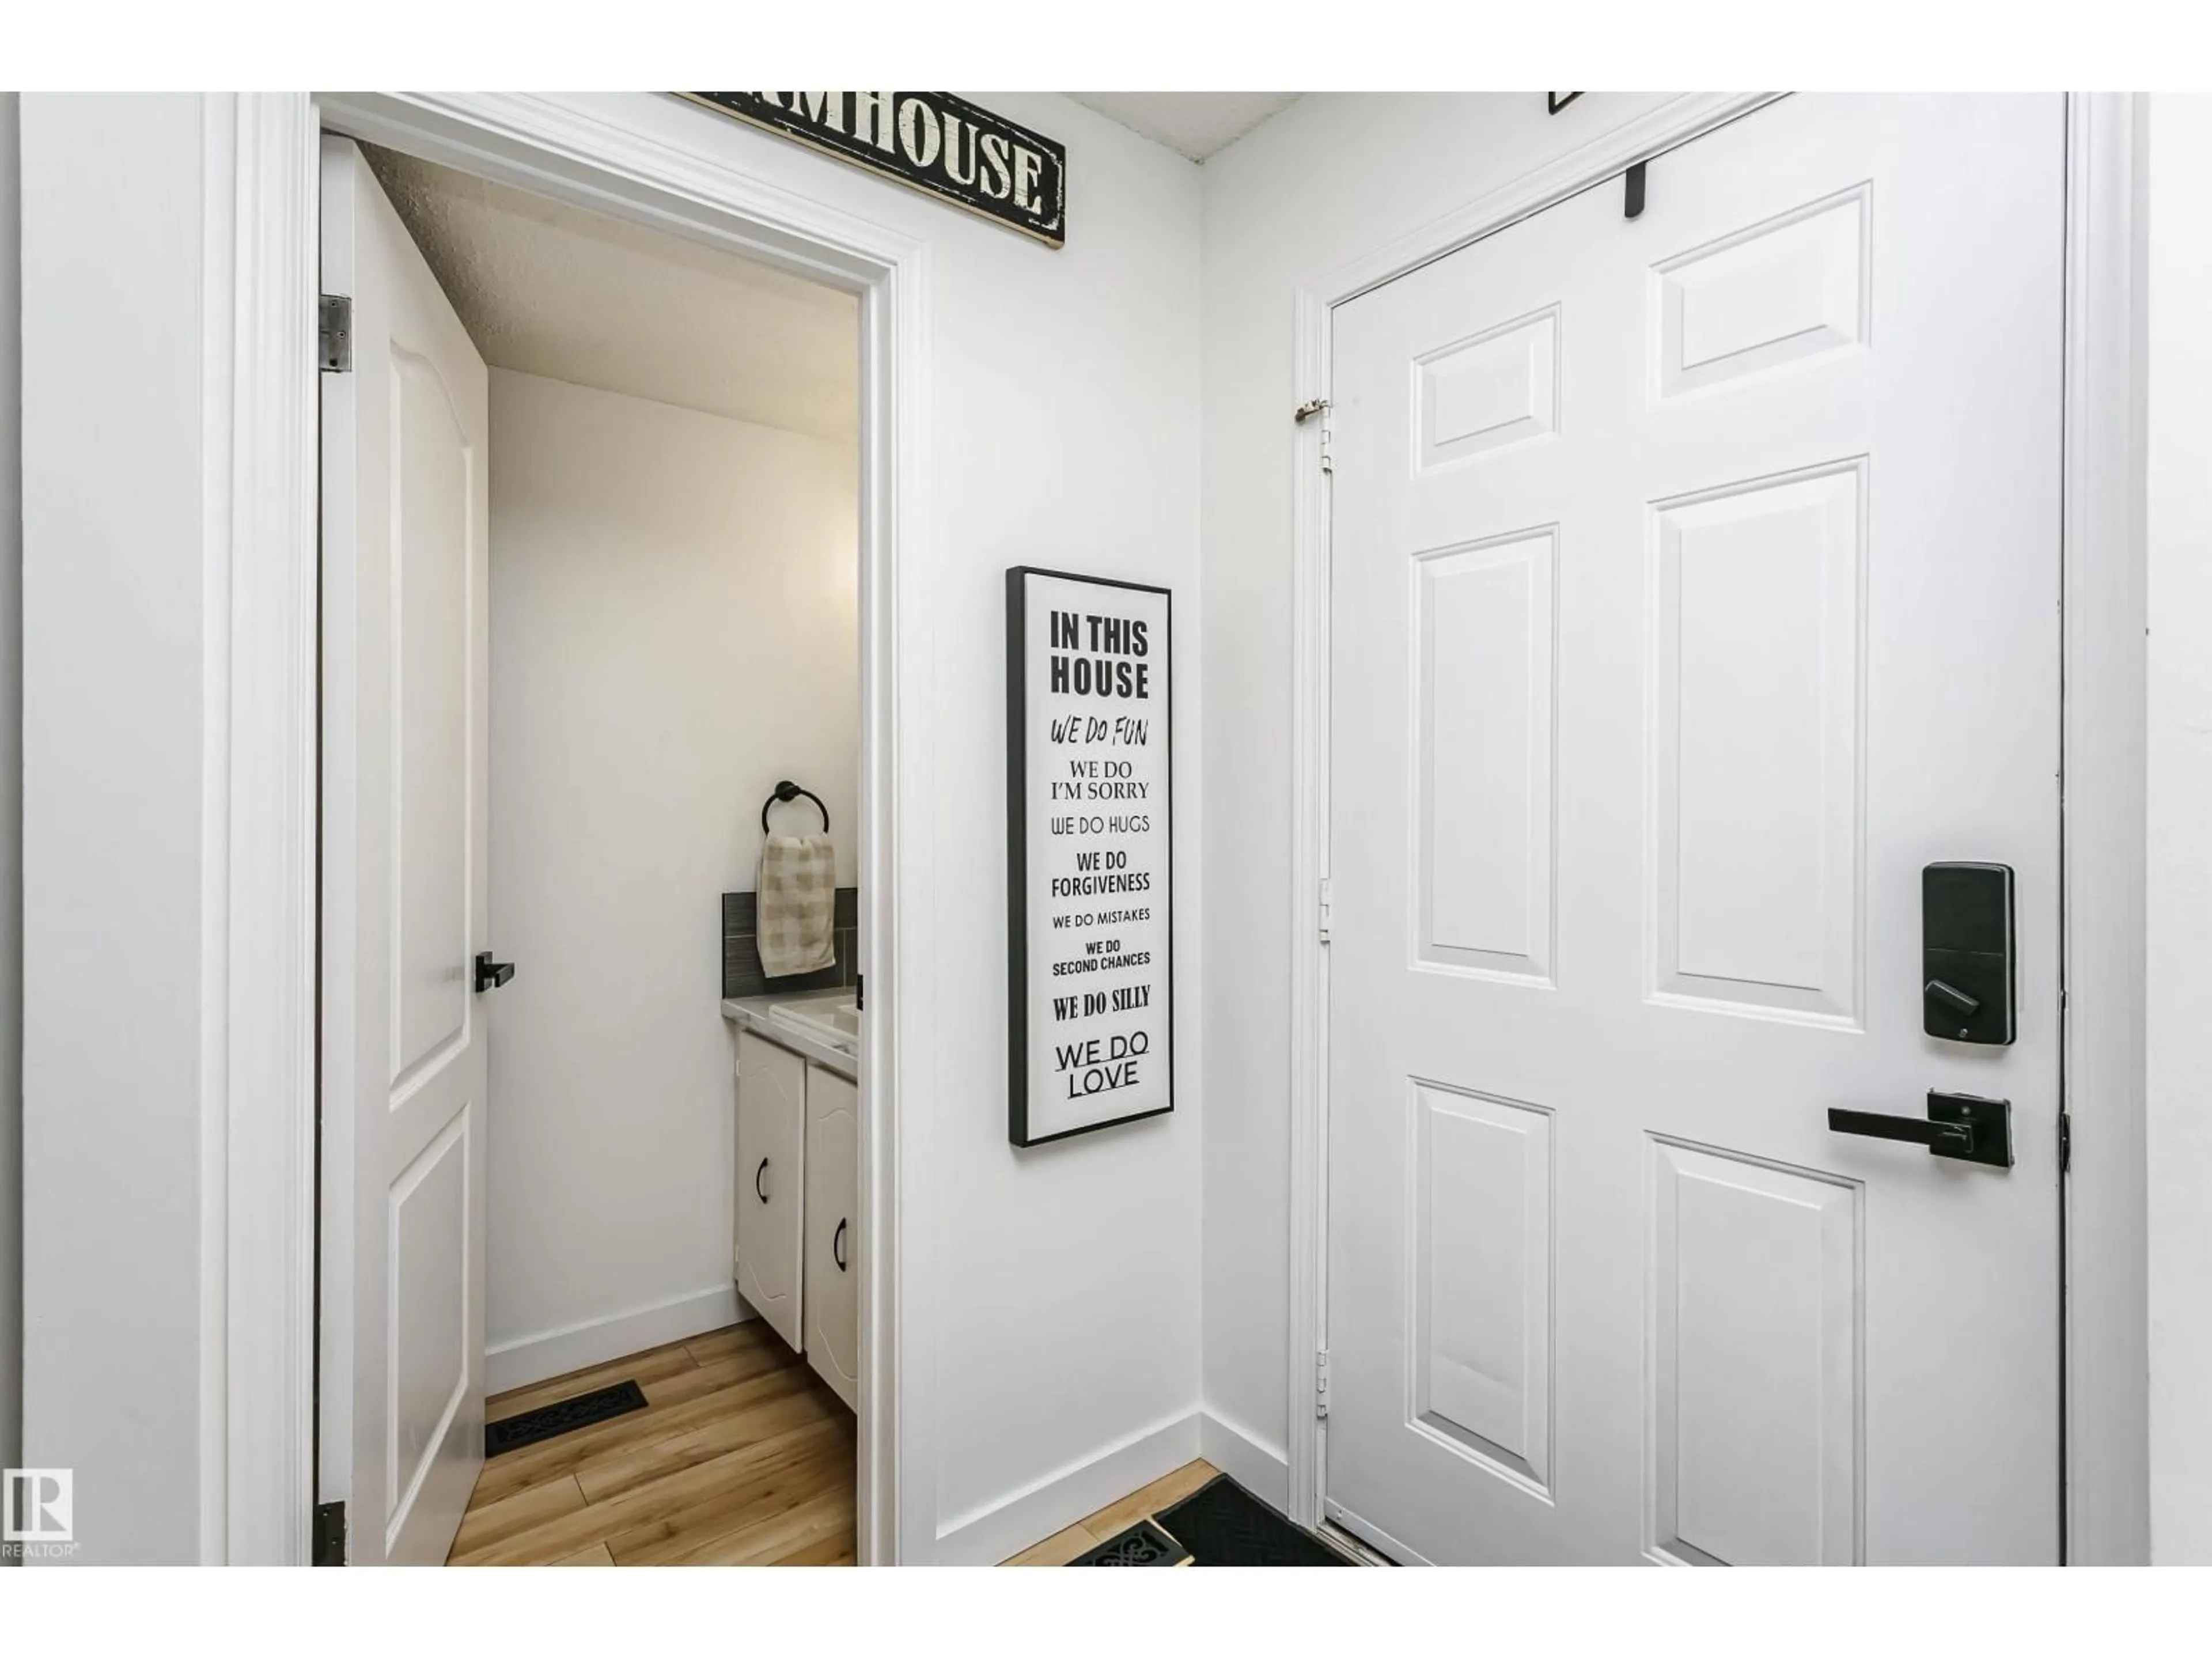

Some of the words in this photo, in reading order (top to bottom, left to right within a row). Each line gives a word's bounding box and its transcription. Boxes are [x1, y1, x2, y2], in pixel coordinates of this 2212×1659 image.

[747, 92, 1042, 215] HOUSE
[1051, 611, 1079, 650] IN
[1086, 615, 1149, 657] THIS
[1051, 655, 1149, 699] HOUSE
[1051, 715, 1082, 744] WE
[1085, 717, 1108, 744] DO
[1113, 716, 1148, 746] FUN
[1070, 761, 1098, 778] WE
[1104, 762, 1131, 778] DO
[1052, 782, 1081, 800] I'M
[1088, 782, 1149, 800] SORRY
[1052, 817, 1074, 835] WE
[1080, 817, 1104, 834] DO
[1109, 816, 1149, 833] HUGS
[1077, 852, 1100, 872] WE
[1106, 851, 1126, 870] DO
[1052, 872, 1150, 897] FORGIVENESS
[1053, 915, 1070, 929] WE
[1075, 914, 1093, 927] DO
[1098, 908, 1150, 925] MISTAKES
[1086, 942, 1103, 955] WE
[1106, 940, 1120, 953] DO
[1053, 959, 1097, 976] SECOND
[1100, 952, 1150, 970] CHANCES
[1053, 995, 1078, 1021] WE
[1084, 991, 1107, 1017] DO
[1112, 984, 1150, 1012] SILLY
[1055, 1039, 1101, 1071] WE
[1111, 1031, 1149, 1060] DO
[1069, 1060, 1140, 1099] LOVE
